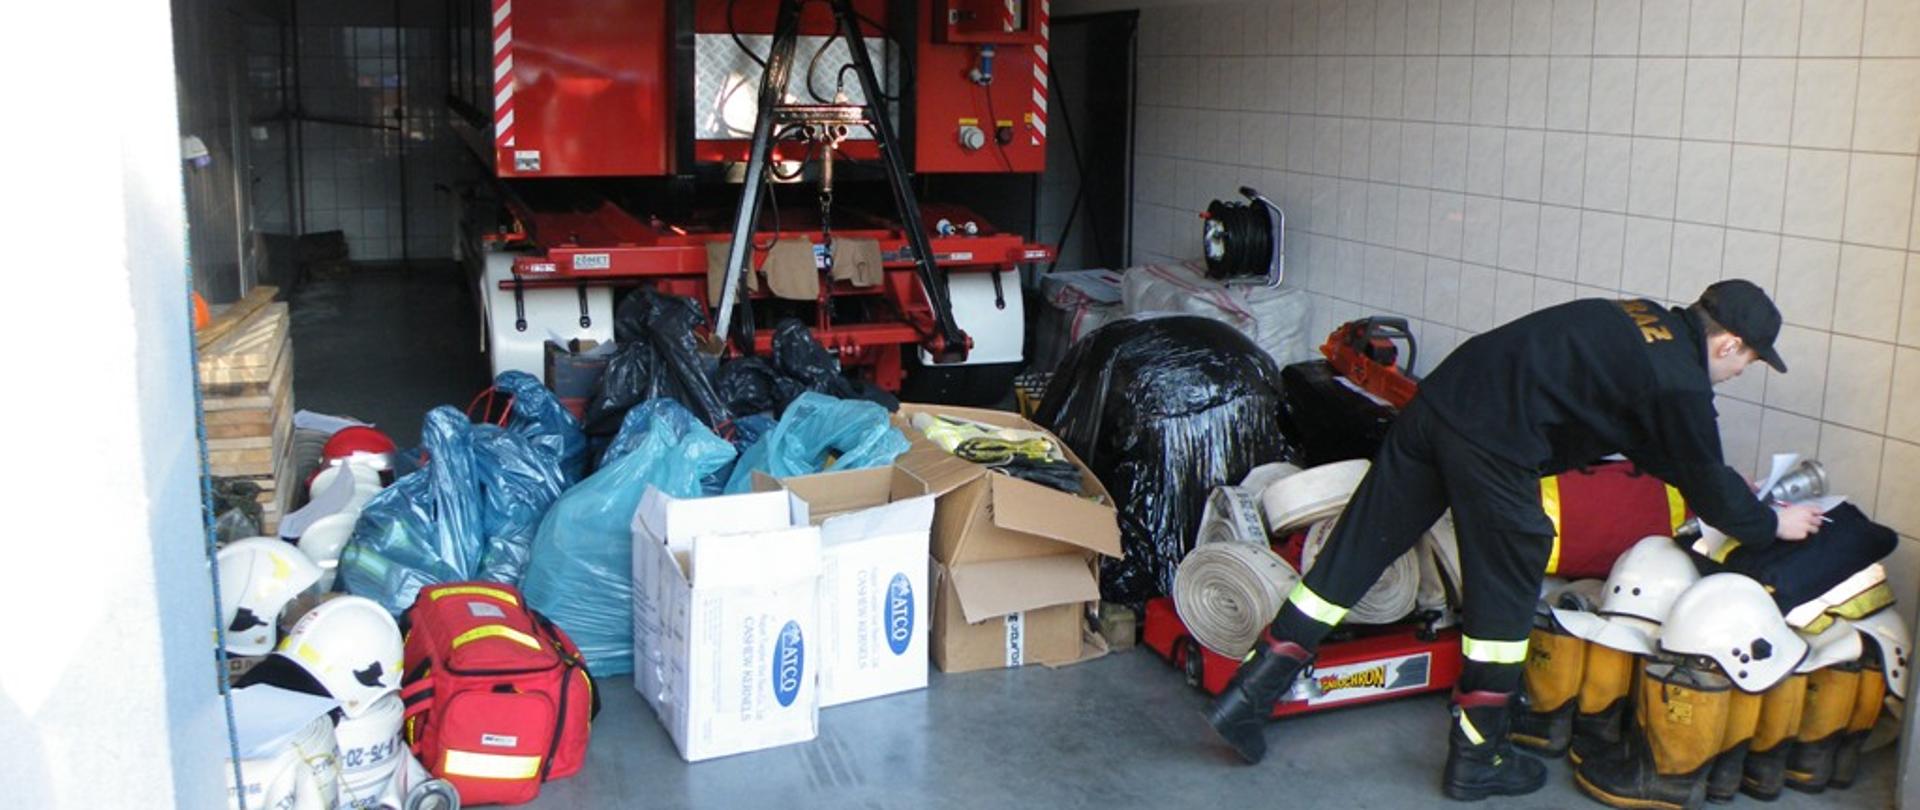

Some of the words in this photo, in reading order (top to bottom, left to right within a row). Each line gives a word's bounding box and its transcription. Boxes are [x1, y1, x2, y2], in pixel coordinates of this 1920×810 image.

[741, 616, 755, 667] CASHEW
[892, 598, 909, 641] ATCO
[782, 647, 799, 692] ATCO
[740, 670, 754, 722] KERNELS
